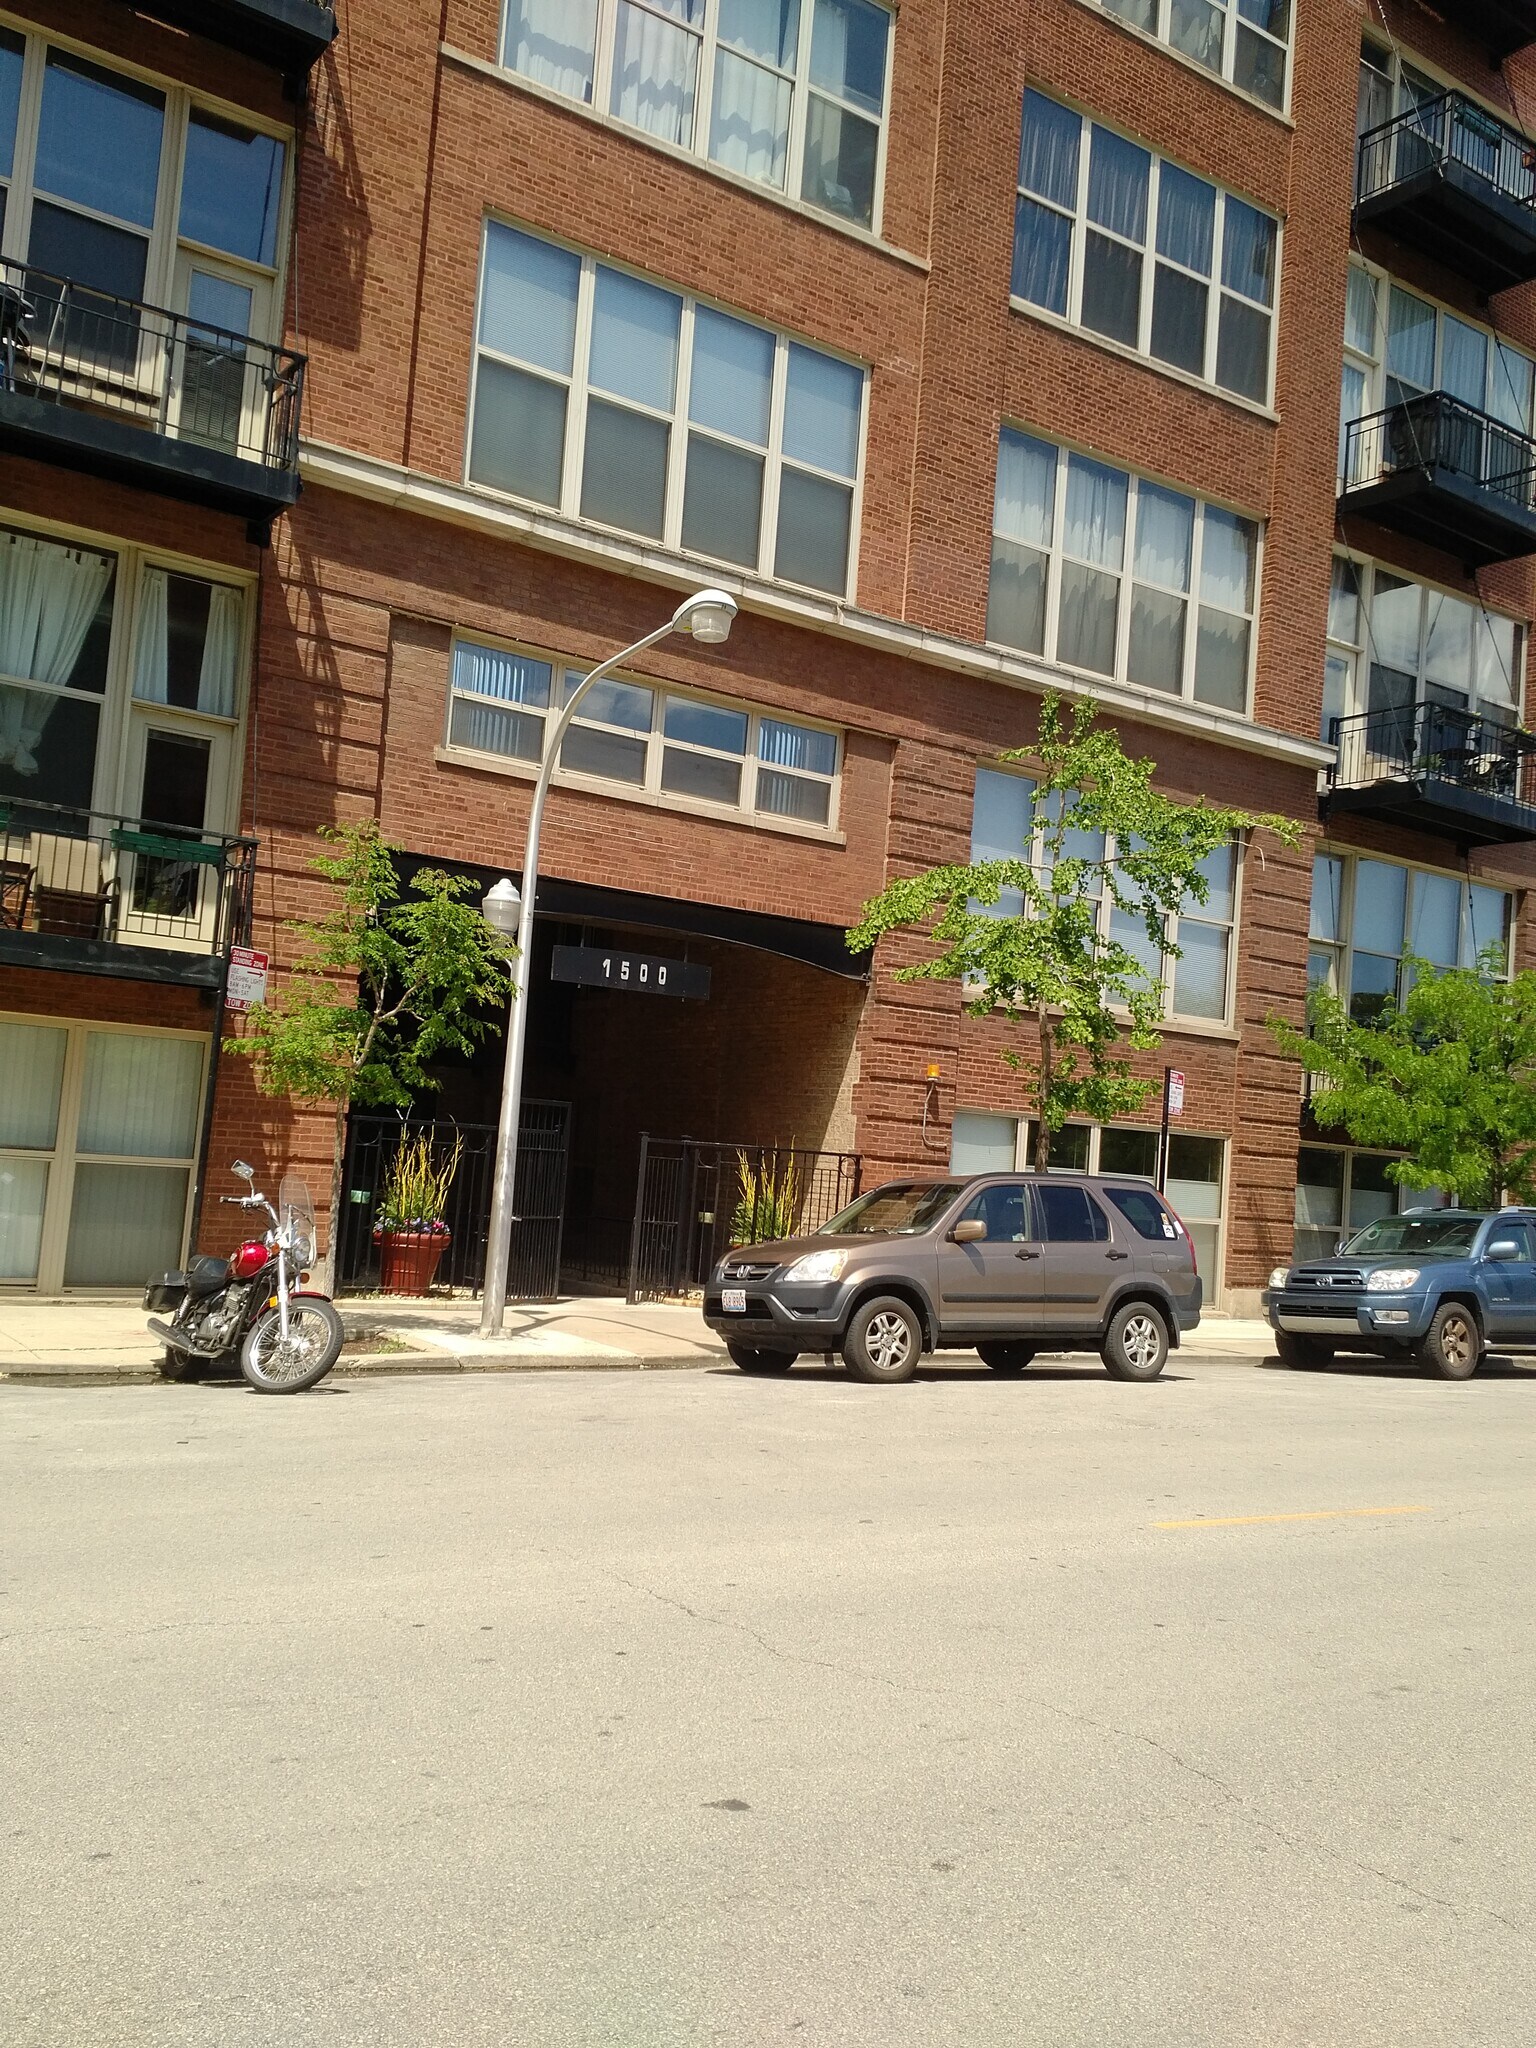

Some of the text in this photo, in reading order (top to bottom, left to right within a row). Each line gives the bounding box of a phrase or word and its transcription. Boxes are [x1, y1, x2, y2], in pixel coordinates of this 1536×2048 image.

[232, 956, 265, 969] STANDING ZONE
[602, 958, 667, 985] 1500
[227, 998, 242, 1007] TOW
